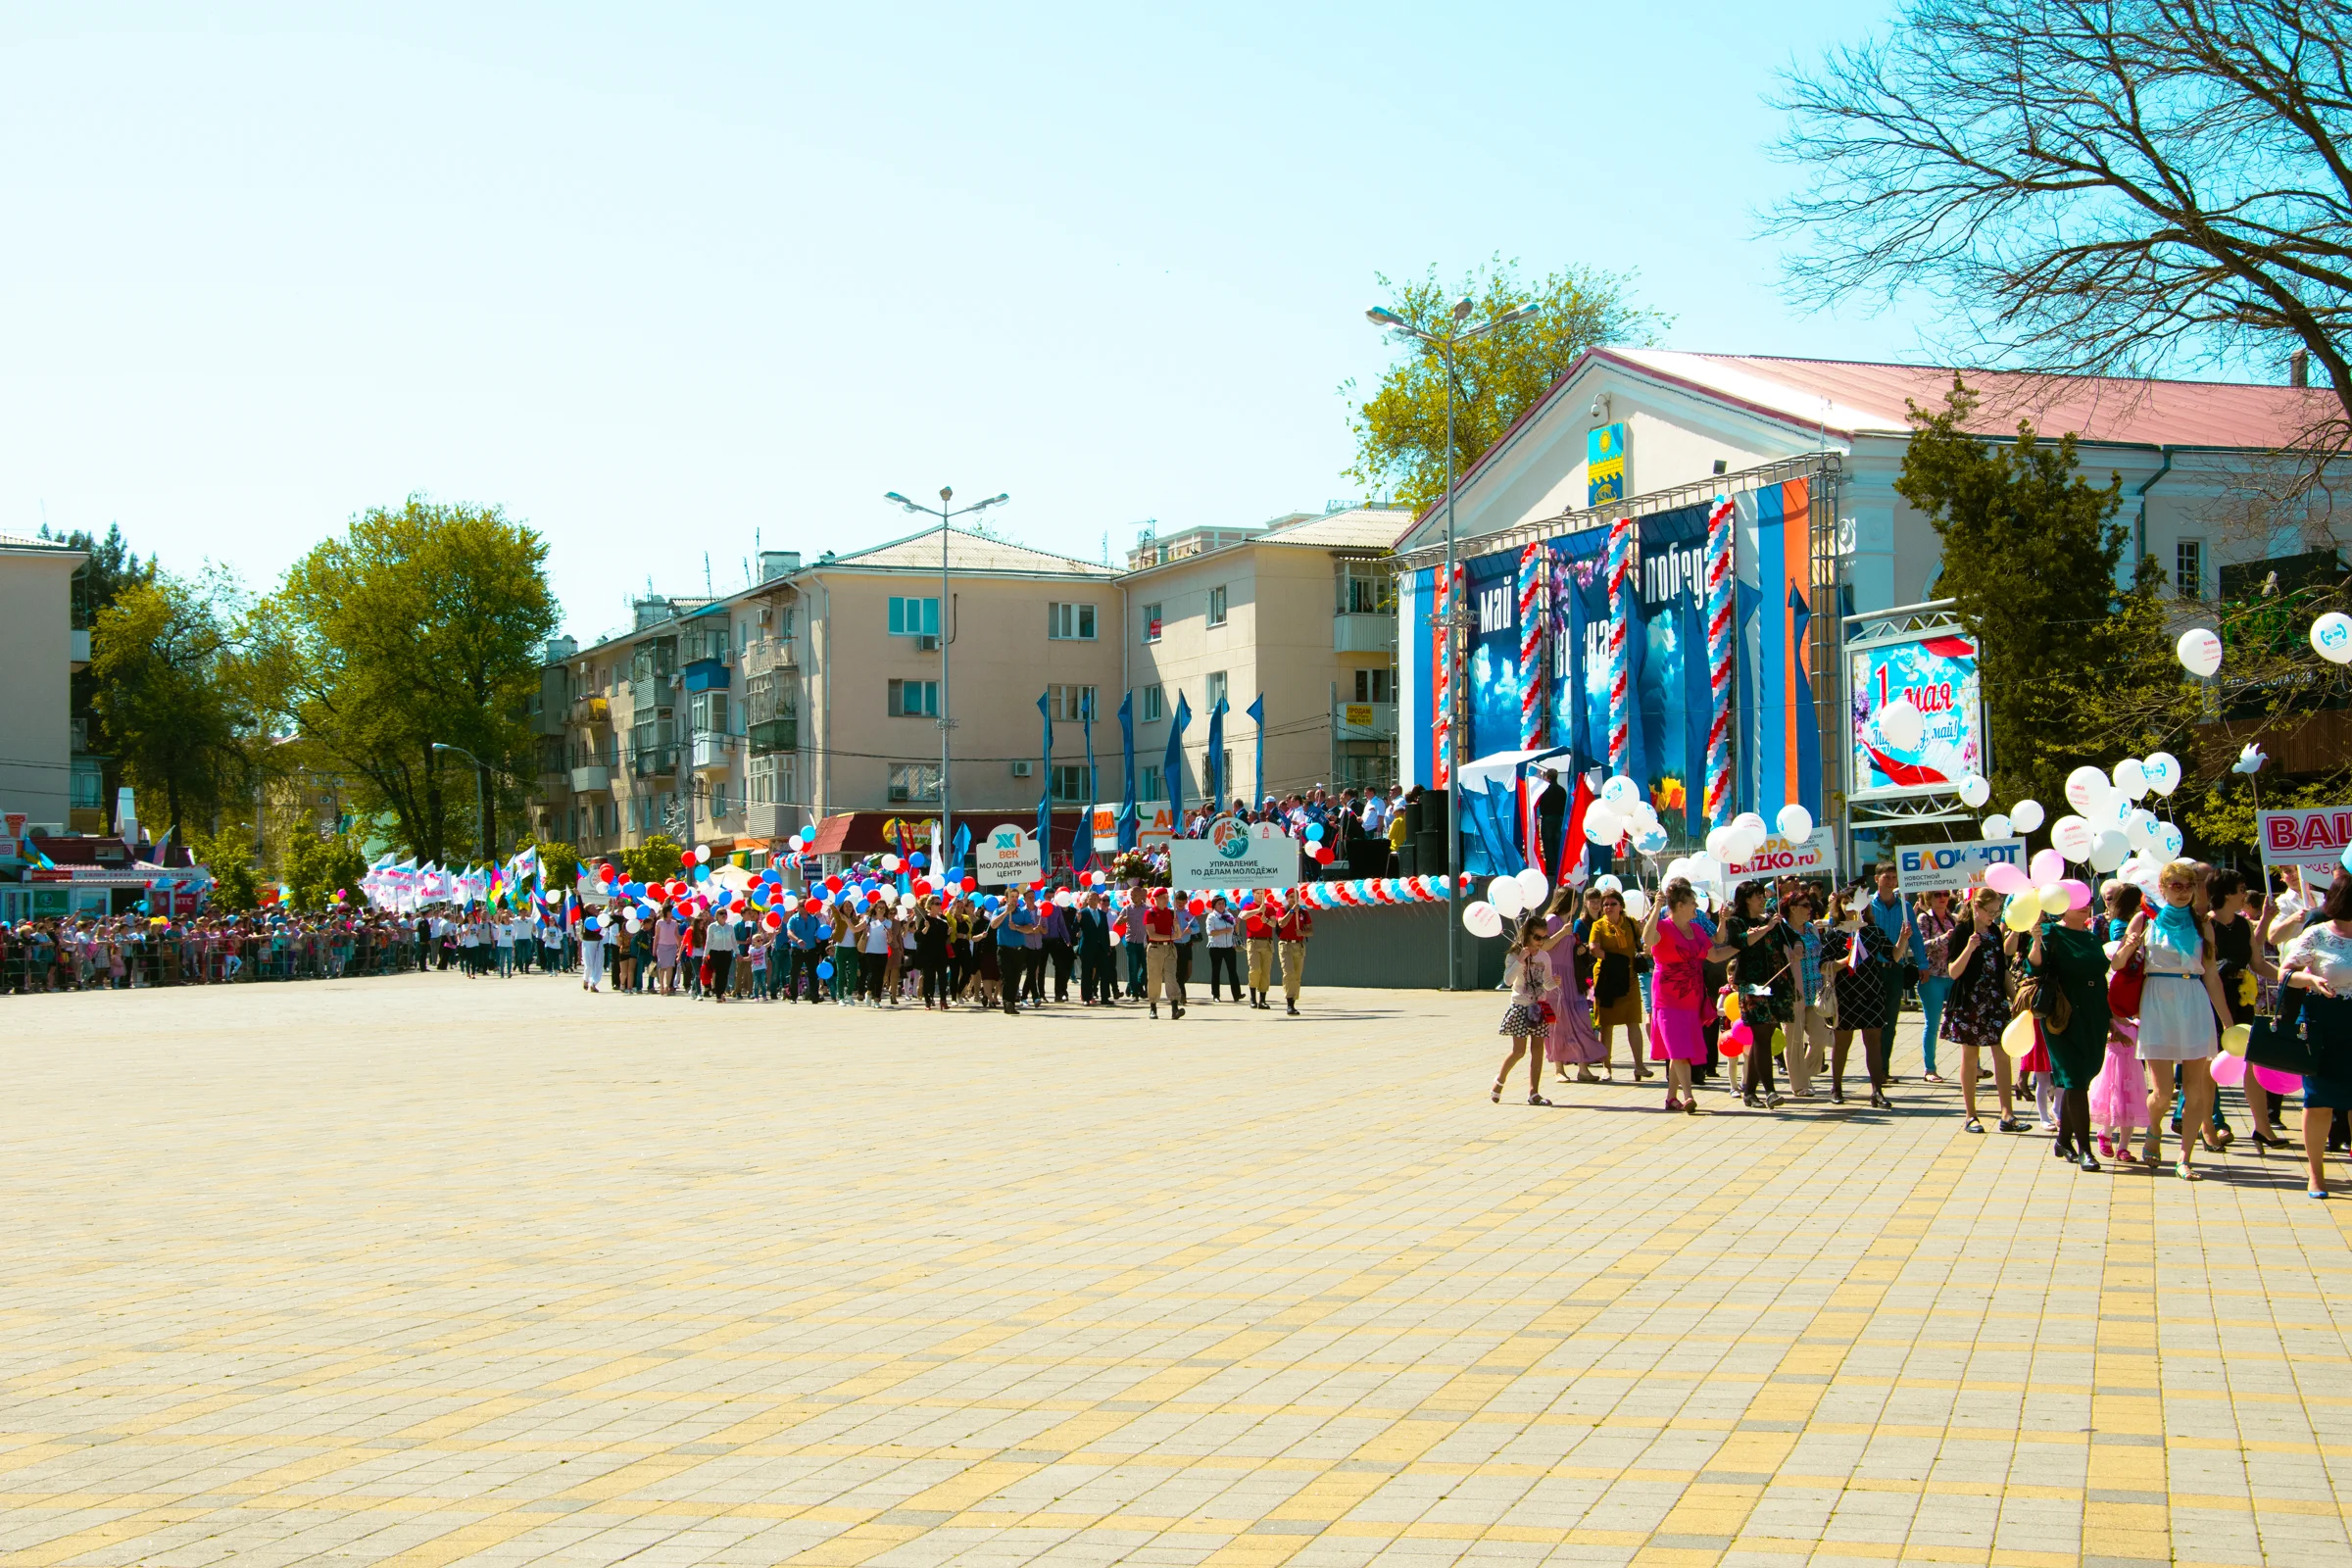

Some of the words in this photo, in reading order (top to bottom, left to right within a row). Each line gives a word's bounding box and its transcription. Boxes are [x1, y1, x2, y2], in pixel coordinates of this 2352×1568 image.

[1481, 575, 1512, 633] май
[1554, 619, 1610, 679] вена
[1903, 682, 1954, 712] мая
[979, 858, 1039, 869] МОЛОДЕЖНЫЙ
[1232, 866, 1278, 875] МОЛОДЁЖИ
